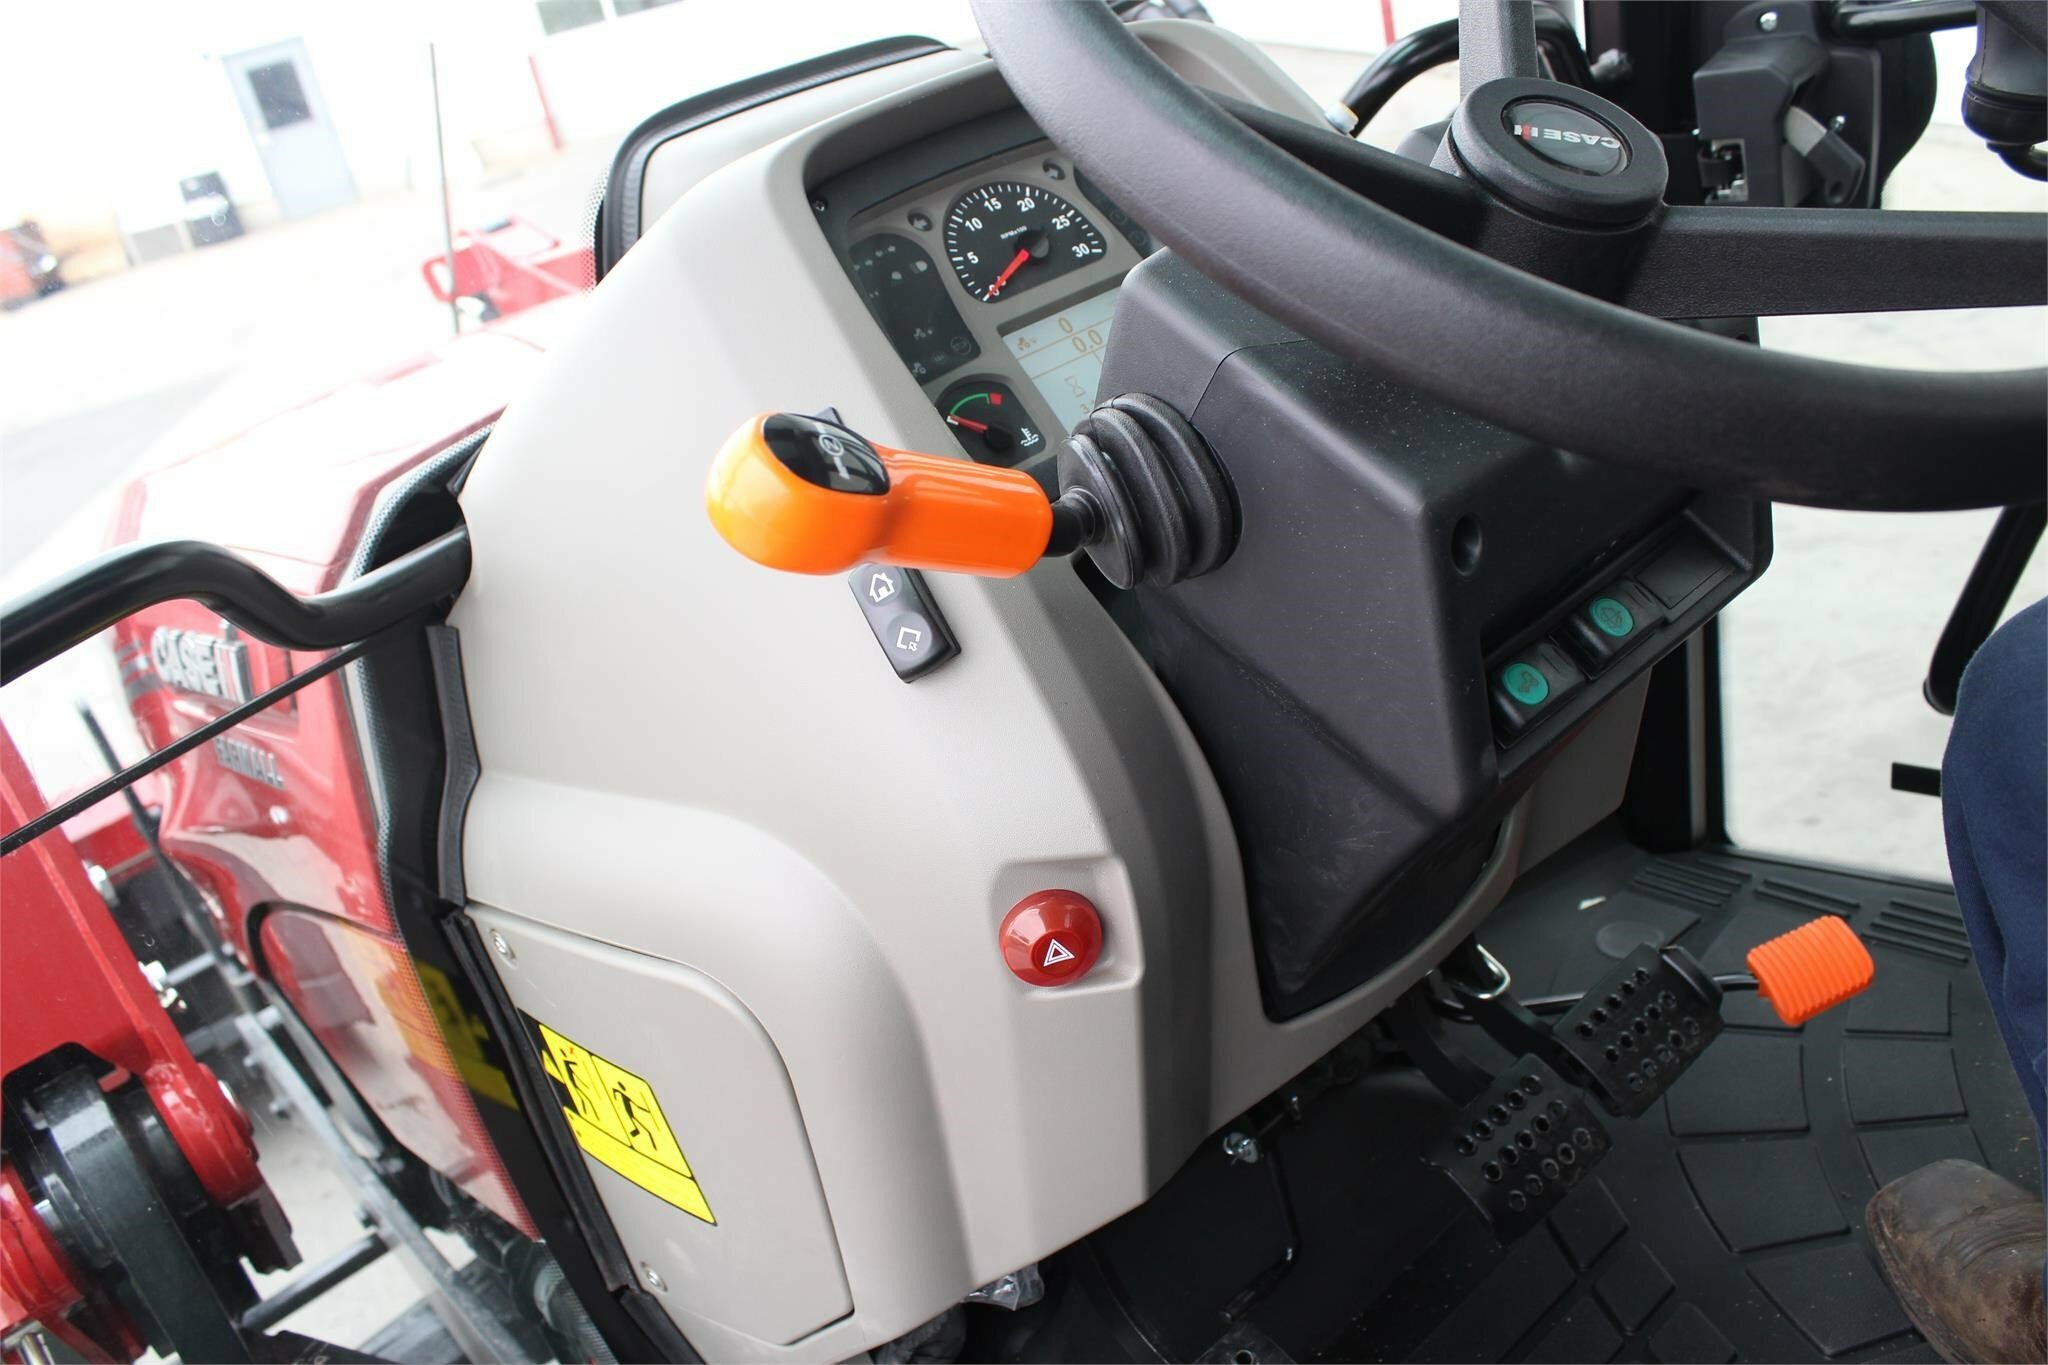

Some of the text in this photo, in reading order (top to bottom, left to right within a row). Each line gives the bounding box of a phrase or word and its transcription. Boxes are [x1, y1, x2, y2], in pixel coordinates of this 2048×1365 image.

[1543, 128, 1621, 148] CASE
[984, 197, 1002, 212] 15
[1017, 197, 1036, 212] 20
[965, 217, 983, 232] 10
[1052, 215, 1071, 230] 25
[967, 251, 979, 264] 5
[1072, 243, 1090, 258] 30
[1058, 317, 1073, 333] 0
[1072, 329, 1103, 353] 0.0
